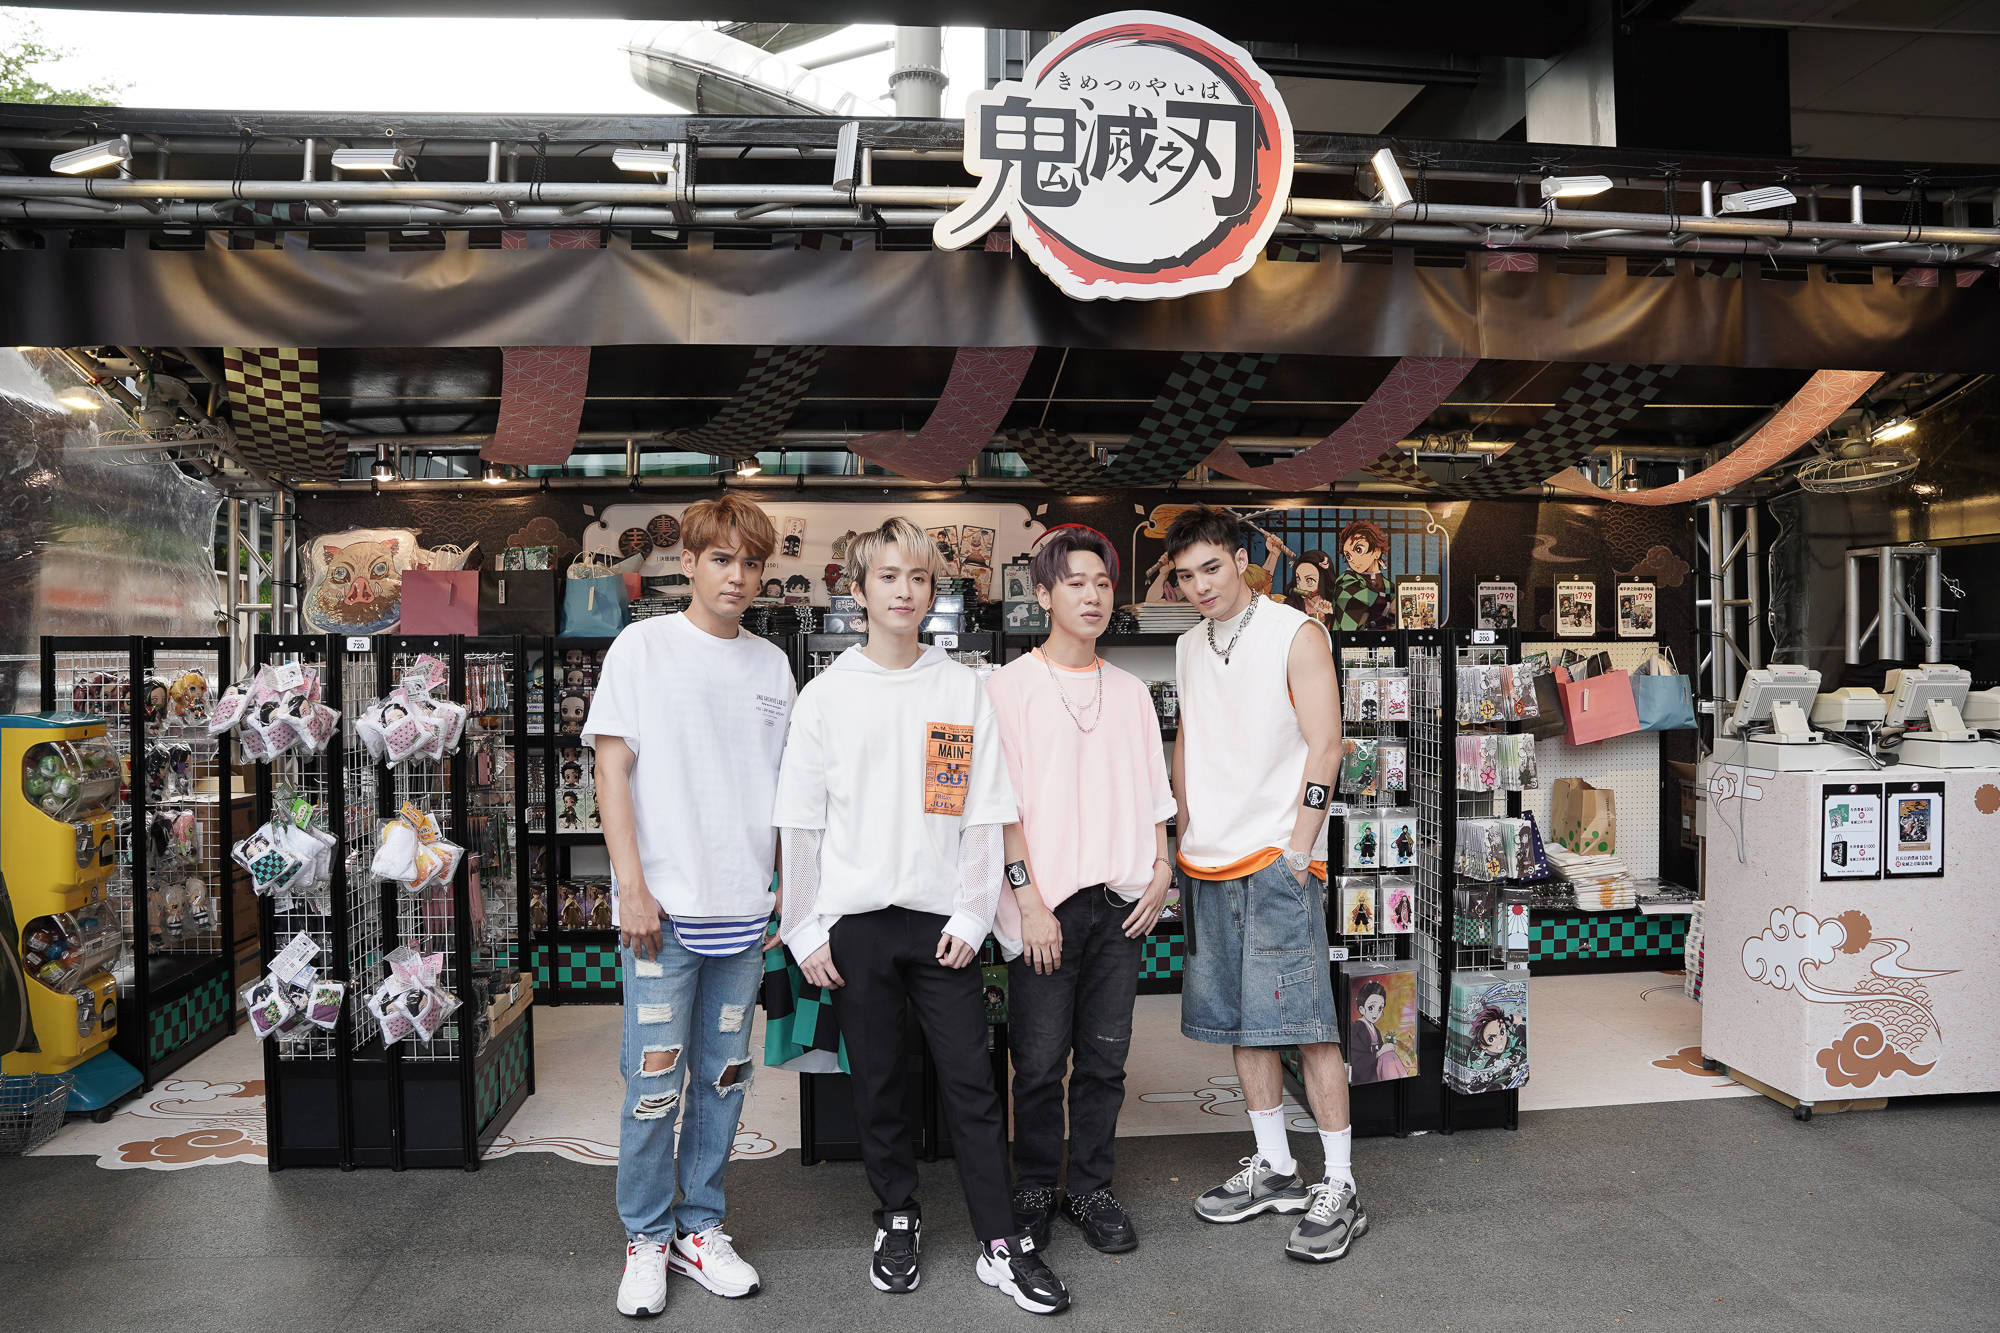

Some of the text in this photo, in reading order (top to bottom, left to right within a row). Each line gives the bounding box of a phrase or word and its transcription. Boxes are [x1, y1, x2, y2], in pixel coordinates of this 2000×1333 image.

[1058, 71, 1220, 99] きめつのやいば
[950, 95, 1254, 235] 鬼滅之刃
[652, 515, 677, 546] 裏
[621, 529, 649, 555] 表
[1417, 592, 1435, 600] $799
[1497, 592, 1514, 600] $799
[1575, 592, 1593, 600] $799
[930, 800, 956, 809] JULY
